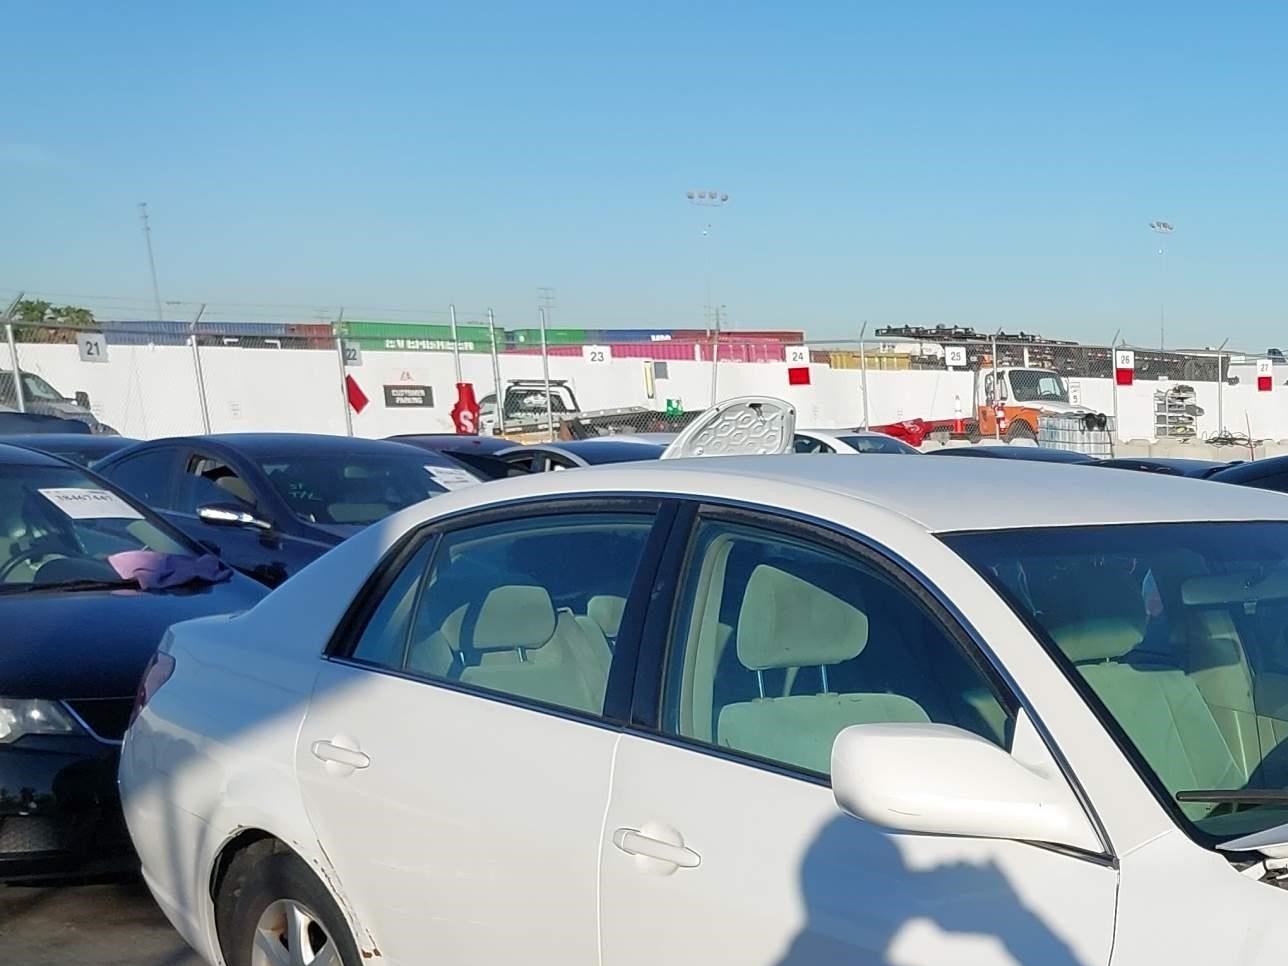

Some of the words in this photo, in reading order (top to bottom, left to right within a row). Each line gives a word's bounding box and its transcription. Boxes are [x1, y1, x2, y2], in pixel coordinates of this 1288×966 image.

[86, 340, 100, 356] 21
[345, 347, 357, 360] 22
[590, 351, 604, 361] 23
[792, 351, 804, 361] 24
[950, 351, 961, 361] 25
[1120, 354, 1130, 365] 26
